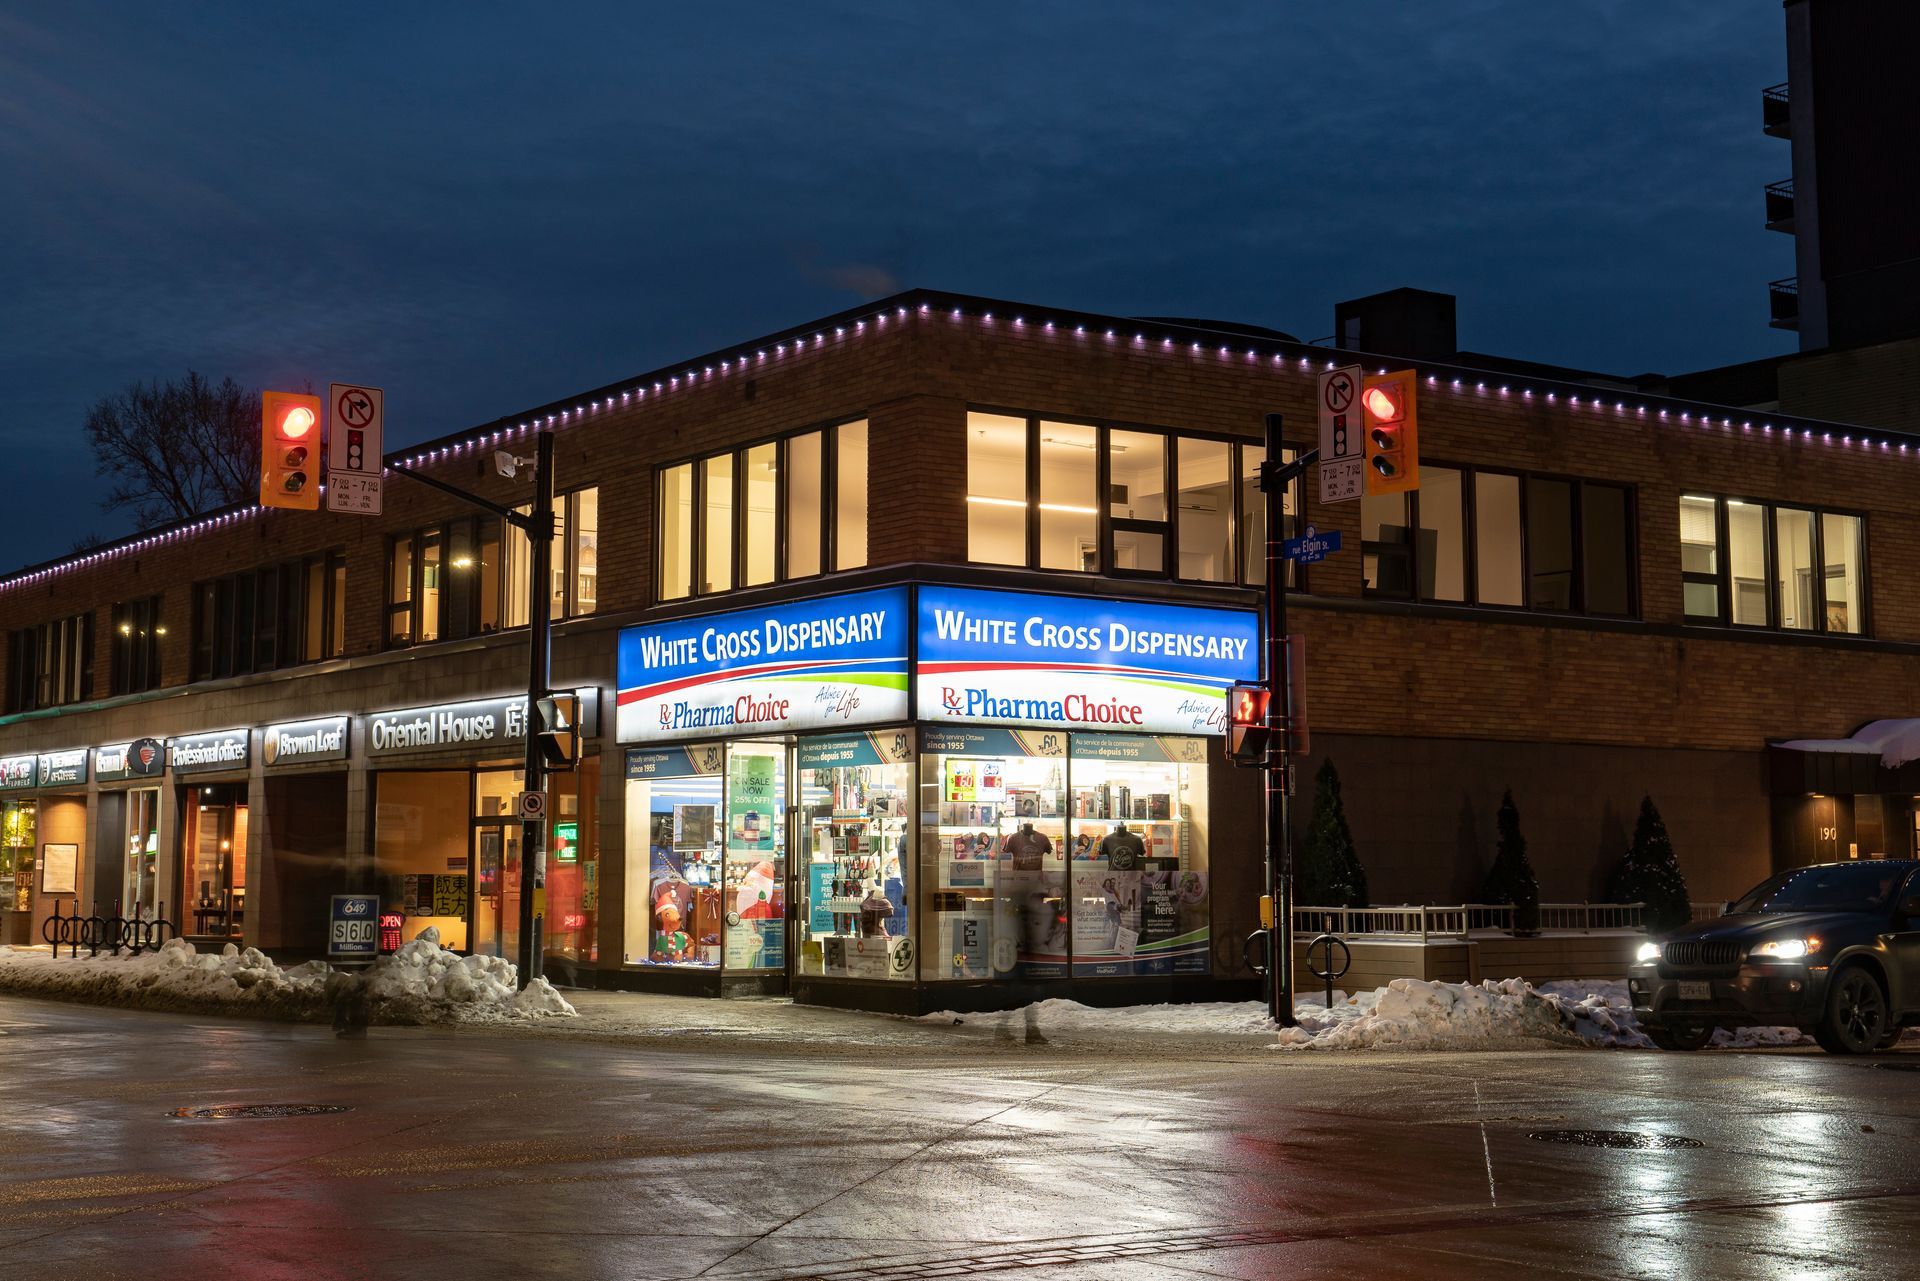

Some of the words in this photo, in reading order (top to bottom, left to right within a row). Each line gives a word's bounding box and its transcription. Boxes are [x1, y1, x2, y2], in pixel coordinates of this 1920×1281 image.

[1323, 470, 1328, 480] 7
[1346, 466, 1350, 476] 7
[332, 478, 338, 488] 7
[361, 481, 366, 491] 7
[1292, 546, 1301, 554] rue
[1302, 538, 1321, 555] Elgin
[640, 636, 698, 669] WHITE
[702, 628, 760, 660] CROSS
[765, 610, 886, 655] DISPENSARY
[934, 609, 1017, 644] WHITE
[1024, 616, 1101, 652] CROSS
[1108, 623, 1248, 660] DISPENSARY
[815, 685, 841, 703] Advice
[834, 686, 860, 720] Life
[964, 688, 1144, 726] PharmaChoice
[1177, 699, 1212, 716] Advice
[672, 693, 790, 729] PharmaChoice
[1192, 714, 1206, 729] for
[1207, 706, 1226, 732] Lif
[372, 712, 436, 750] Oriental
[439, 712, 494, 744] House
[925, 732, 946, 741] Proudly
[946, 734, 965, 742] serving
[280, 733, 316, 756] Brown
[317, 725, 343, 752] Loaf
[927, 741, 945, 749] since
[947, 742, 964, 750] 1955
[172, 742, 219, 766] Professional
[219, 738, 246, 762] offices
[820, 752, 839, 762] depuis
[840, 750, 854, 759] 1955
[1098, 747, 1120, 757] depuis
[630, 765, 643, 773] since
[644, 764, 656, 772] 1955
[735, 777, 748, 785] ON
[750, 777, 770, 786] SALE
[742, 786, 764, 795] NOW
[734, 796, 752, 804] 25%
[1820, 827, 1837, 840] 190
[1152, 882, 1166, 890] Your
[1155, 905, 1176, 915] here.
[380, 915, 401, 927] OPEN
